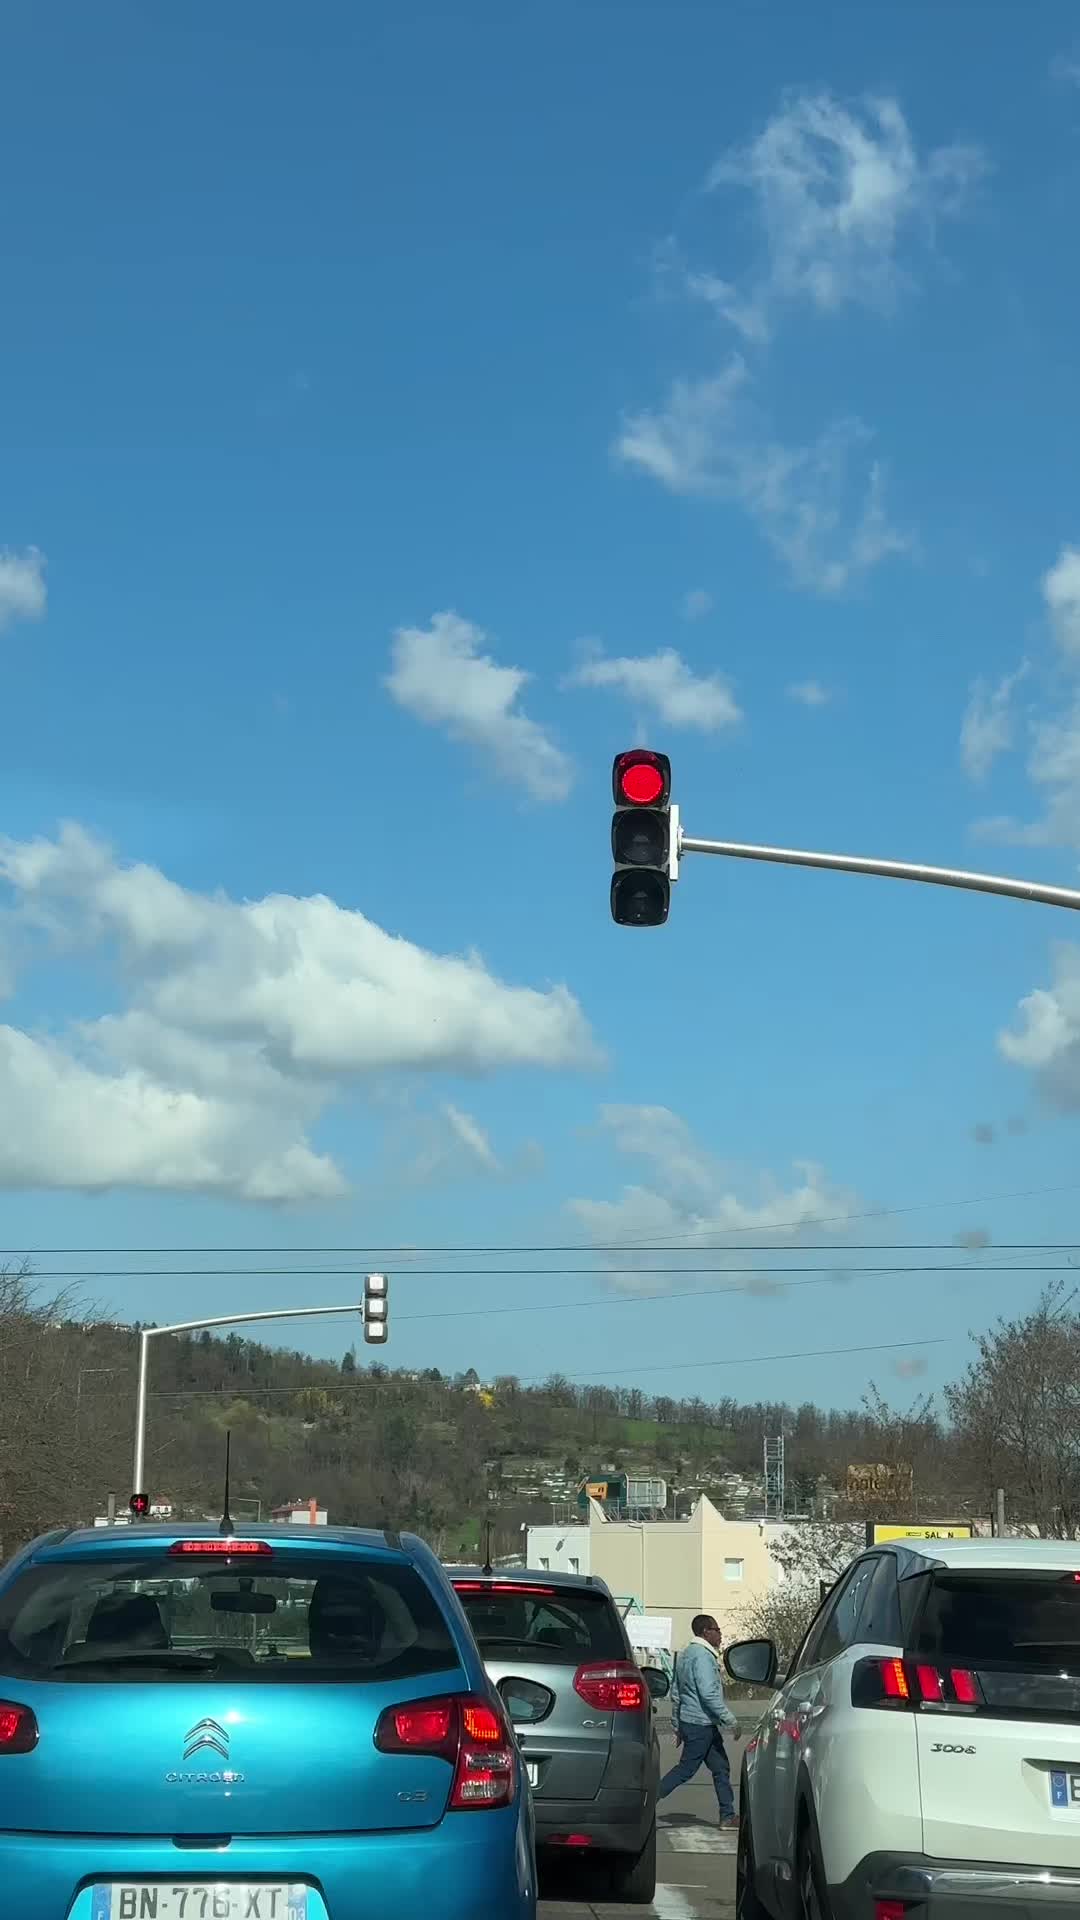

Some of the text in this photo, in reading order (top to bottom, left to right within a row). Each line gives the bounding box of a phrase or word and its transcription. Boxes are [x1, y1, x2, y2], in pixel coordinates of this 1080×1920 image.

[925, 1531, 954, 1539] SALN
[930, 1743, 976, 1754] 3008
[119, 1887, 282, 1919] BN-776-XT
